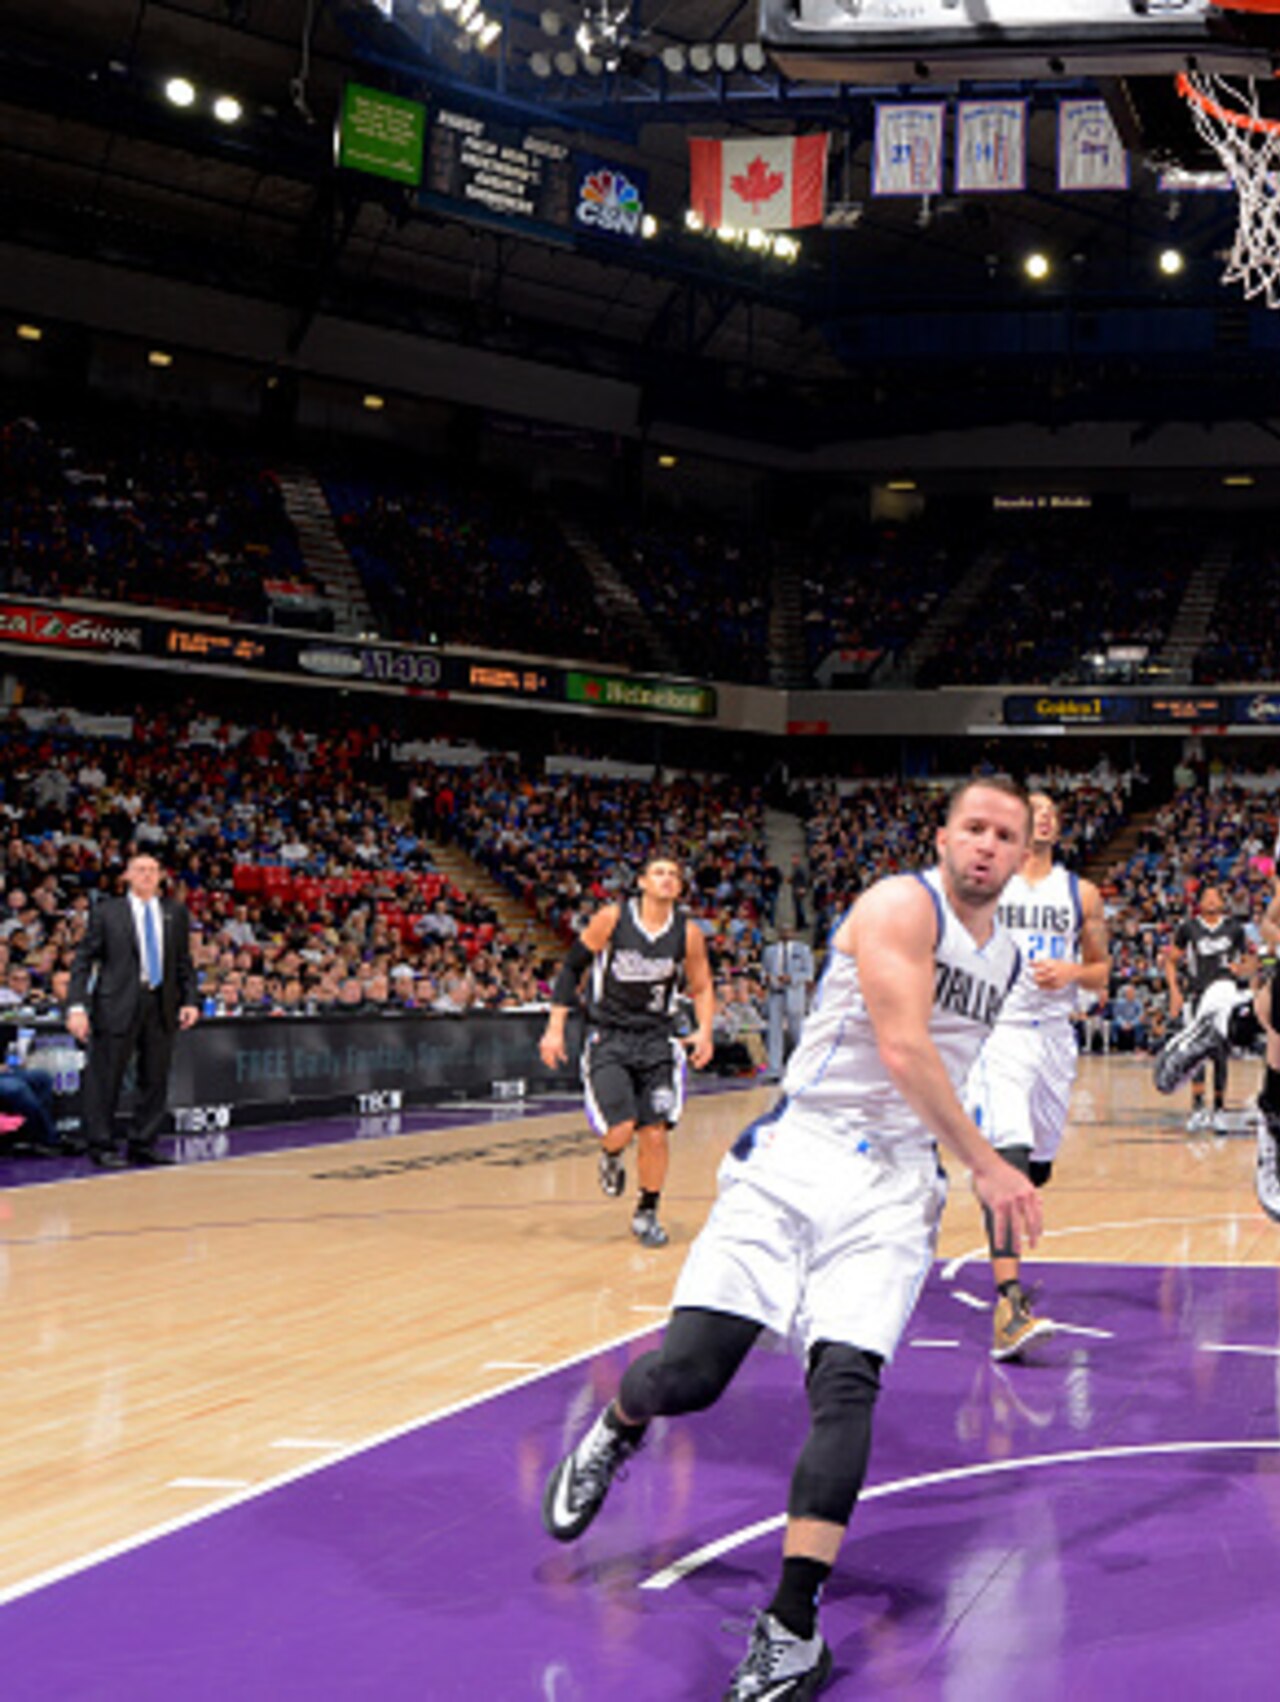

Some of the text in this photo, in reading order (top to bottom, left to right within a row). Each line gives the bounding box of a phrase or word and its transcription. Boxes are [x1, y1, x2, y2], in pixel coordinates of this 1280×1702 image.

[575, 201, 640, 236] CSN
[997, 904, 1070, 933] ALLAS
[648, 984, 667, 1013] 3
[236, 1048, 287, 1084] FREE
